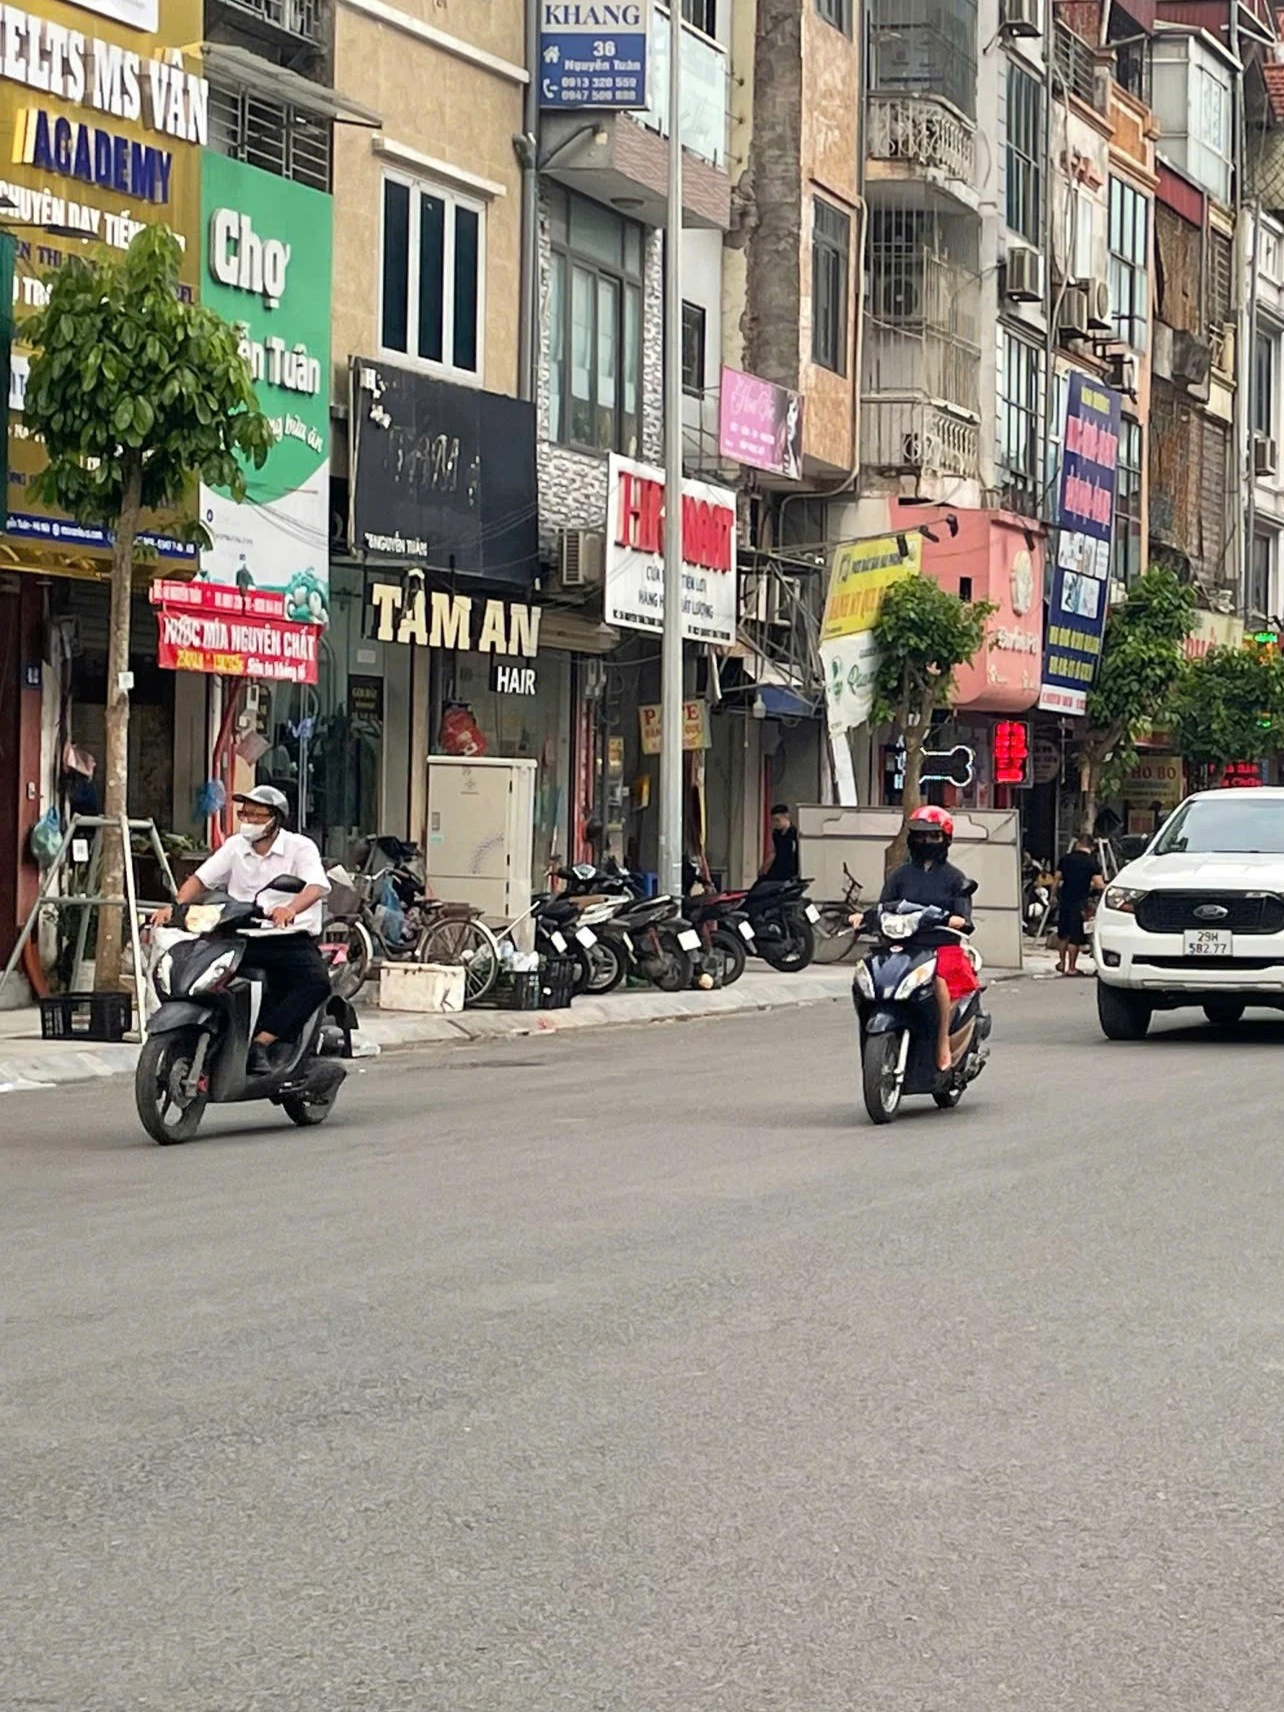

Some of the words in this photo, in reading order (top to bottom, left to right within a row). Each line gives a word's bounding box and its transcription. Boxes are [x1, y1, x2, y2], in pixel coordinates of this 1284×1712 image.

[545, 4, 641, 26] KHANG
[0, 3, 85, 99] ELTS
[92, 37, 141, 122] MS
[150, 48, 209, 146] VÂN
[33, 109, 173, 205] ACADEMY
[212, 208, 292, 309] Chợ
[231, 623, 282, 656] NGUYÊN
[283, 626, 316, 662] CHẤT
[478, 599, 543, 658] AN
[496, 665, 536, 696] HAIR
[1197, 931, 1219, 942] 29H
